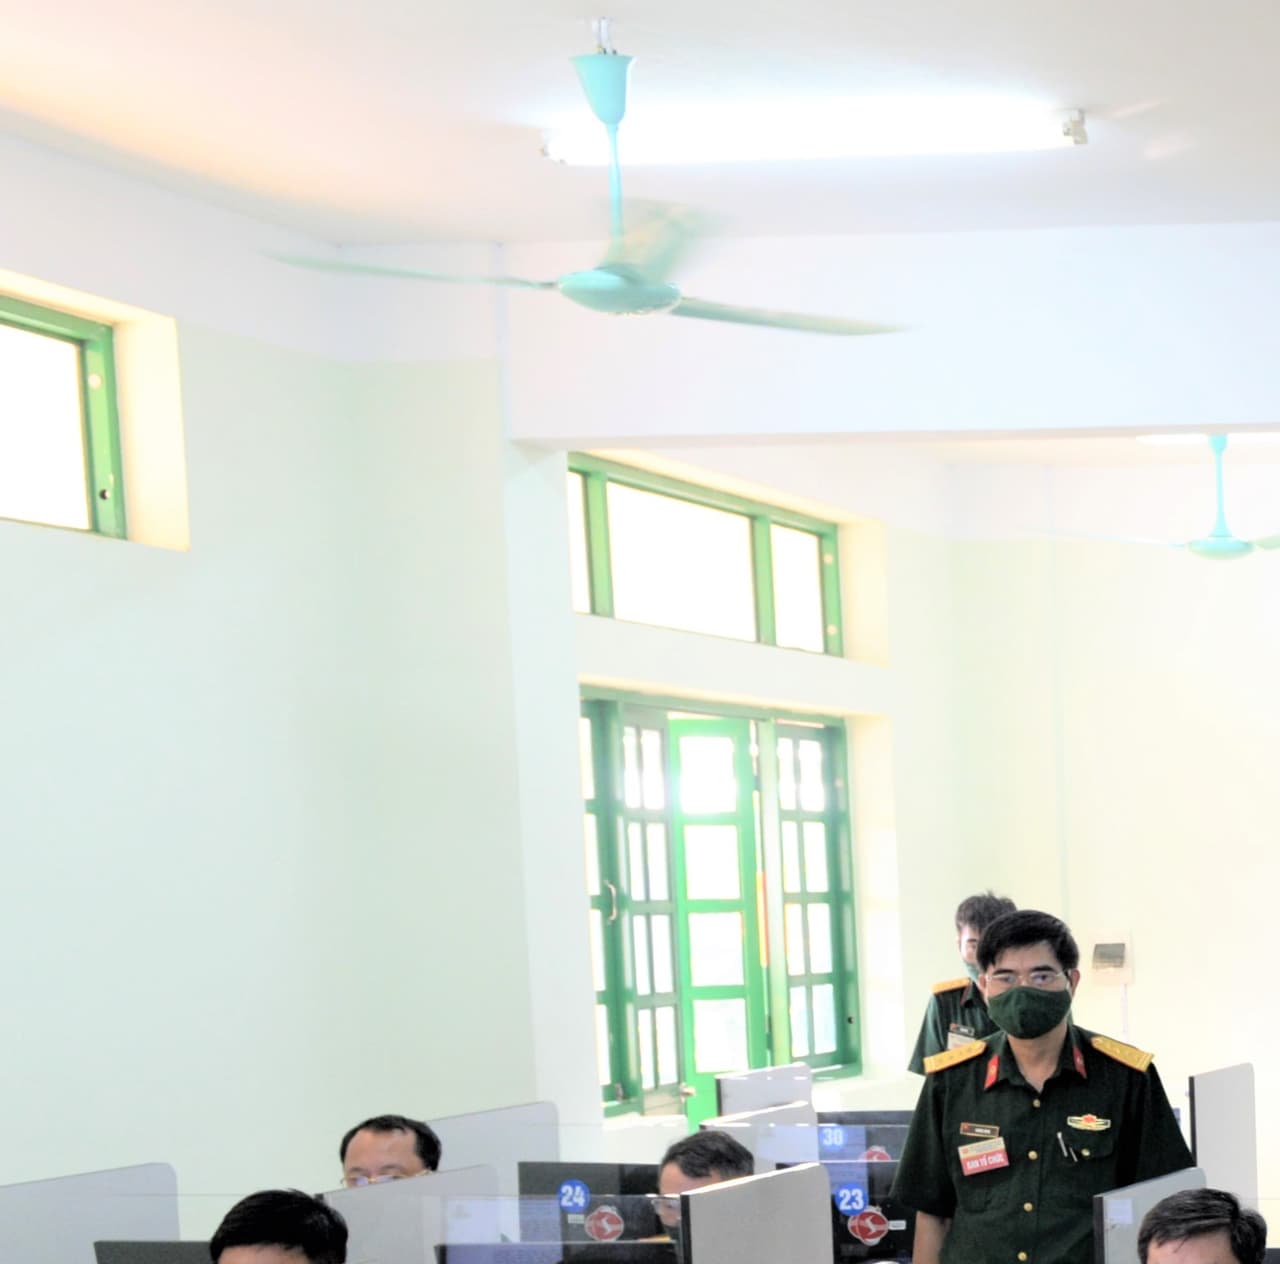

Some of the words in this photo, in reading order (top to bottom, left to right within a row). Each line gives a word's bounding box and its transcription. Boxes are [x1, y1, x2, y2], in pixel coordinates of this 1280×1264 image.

[823, 1129, 844, 1146] 30
[561, 1185, 586, 1207] 24
[839, 1188, 865, 1211] 23
